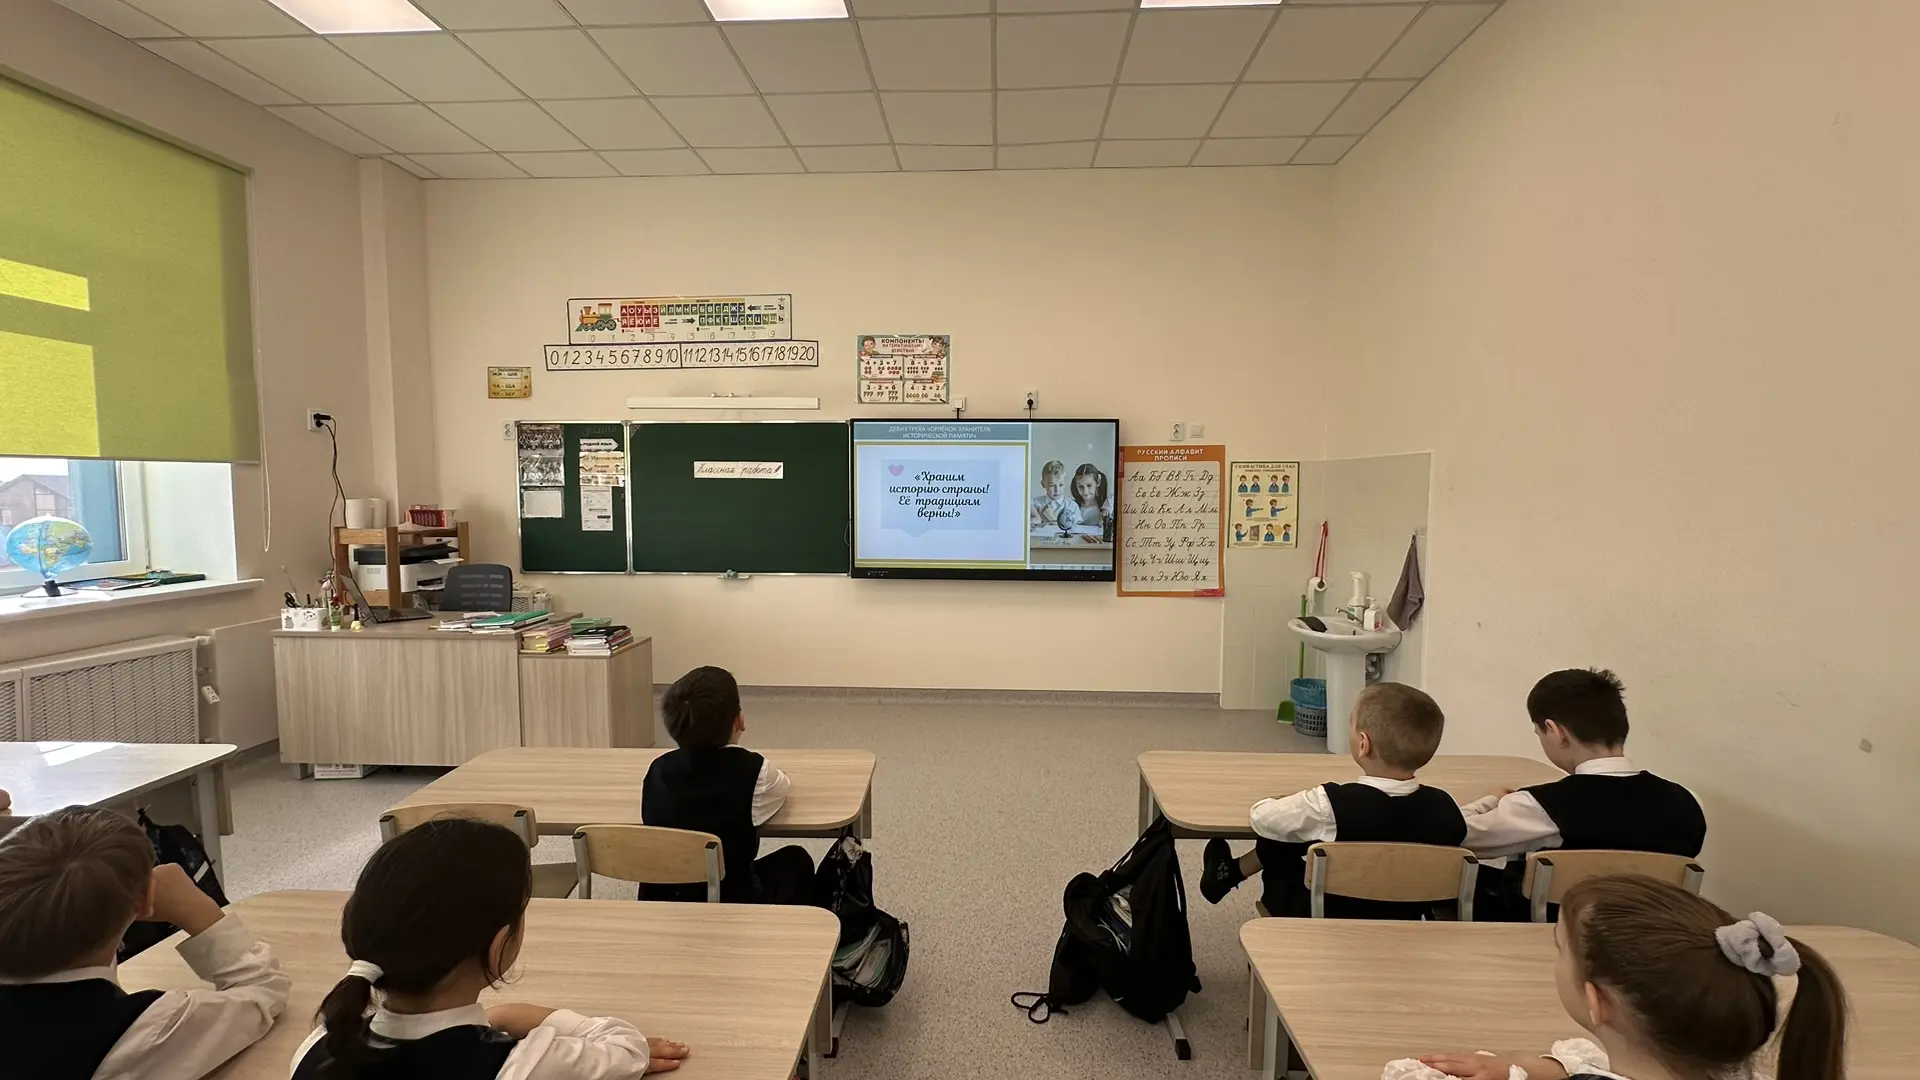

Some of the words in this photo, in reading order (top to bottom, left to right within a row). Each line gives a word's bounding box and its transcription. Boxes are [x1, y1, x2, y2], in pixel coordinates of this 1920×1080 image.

[550, 351, 559, 365] 0
[563, 351, 568, 365] 1
[572, 351, 580, 364] 2
[585, 350, 592, 364] 3
[596, 350, 604, 364] 4
[609, 350, 617, 364] 5
[621, 350, 629, 364] 6
[632, 350, 640, 363] 7
[643, 349, 651, 363] 8
[655, 349, 663, 363] 9
[666, 348, 678, 363] 10
[684, 348, 693, 362] 11
[695, 348, 706, 362] 12
[709, 348, 720, 362] 13
[722, 348, 733, 362] 14
[736, 347, 747, 361] 15
[749, 346, 760, 361] 16
[761, 346, 773, 360] 17
[774, 346, 785, 360] 18
[787, 346, 798, 360] 19
[799, 346, 815, 360] 20
[698, 463, 735, 473] Классная
[740, 463, 772, 476] работа
[914, 471, 965, 485] «Храним
[889, 486, 940, 497] историю
[942, 484, 990, 497] страны!
[899, 496, 911, 505] Её
[915, 498, 980, 509] традициям
[918, 507, 961, 521] верны!»
